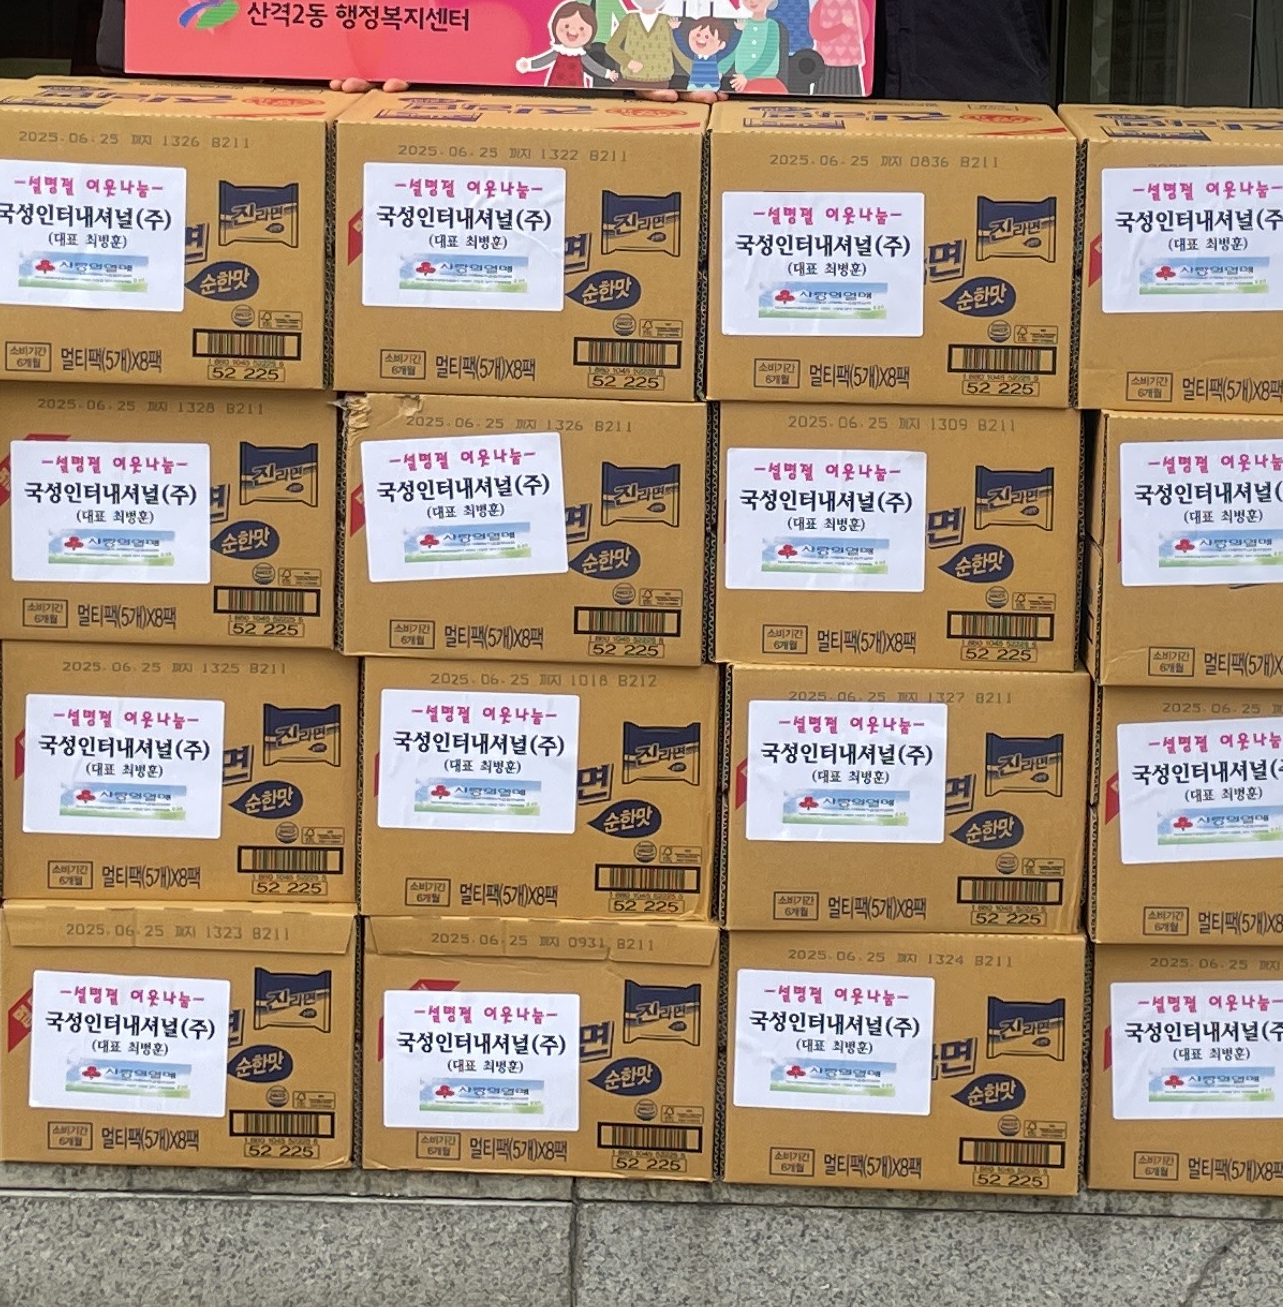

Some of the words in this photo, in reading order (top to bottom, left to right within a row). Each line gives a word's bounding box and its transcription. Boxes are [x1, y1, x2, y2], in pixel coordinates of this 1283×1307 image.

[247, 0, 328, 28] 산격2동
[335, 4, 470, 32] 행정복지센터
[376, 204, 552, 233] 국성인터내셔널(주)
[735, 232, 911, 259] 국성인터내셔널(주)
[787, 262, 818, 276] (대표
[956, 283, 1007, 313] 순한맛
[967, 383, 991, 394] 52
[998, 383, 1034, 395] 225
[739, 487, 913, 515] 국성인터내셔널(주)
[392, 729, 565, 758] 국성인터내셔널(주)
[43, 1009, 216, 1042] 국성인터내셔널(주)
[1173, 1048, 1202, 1060] (대표
